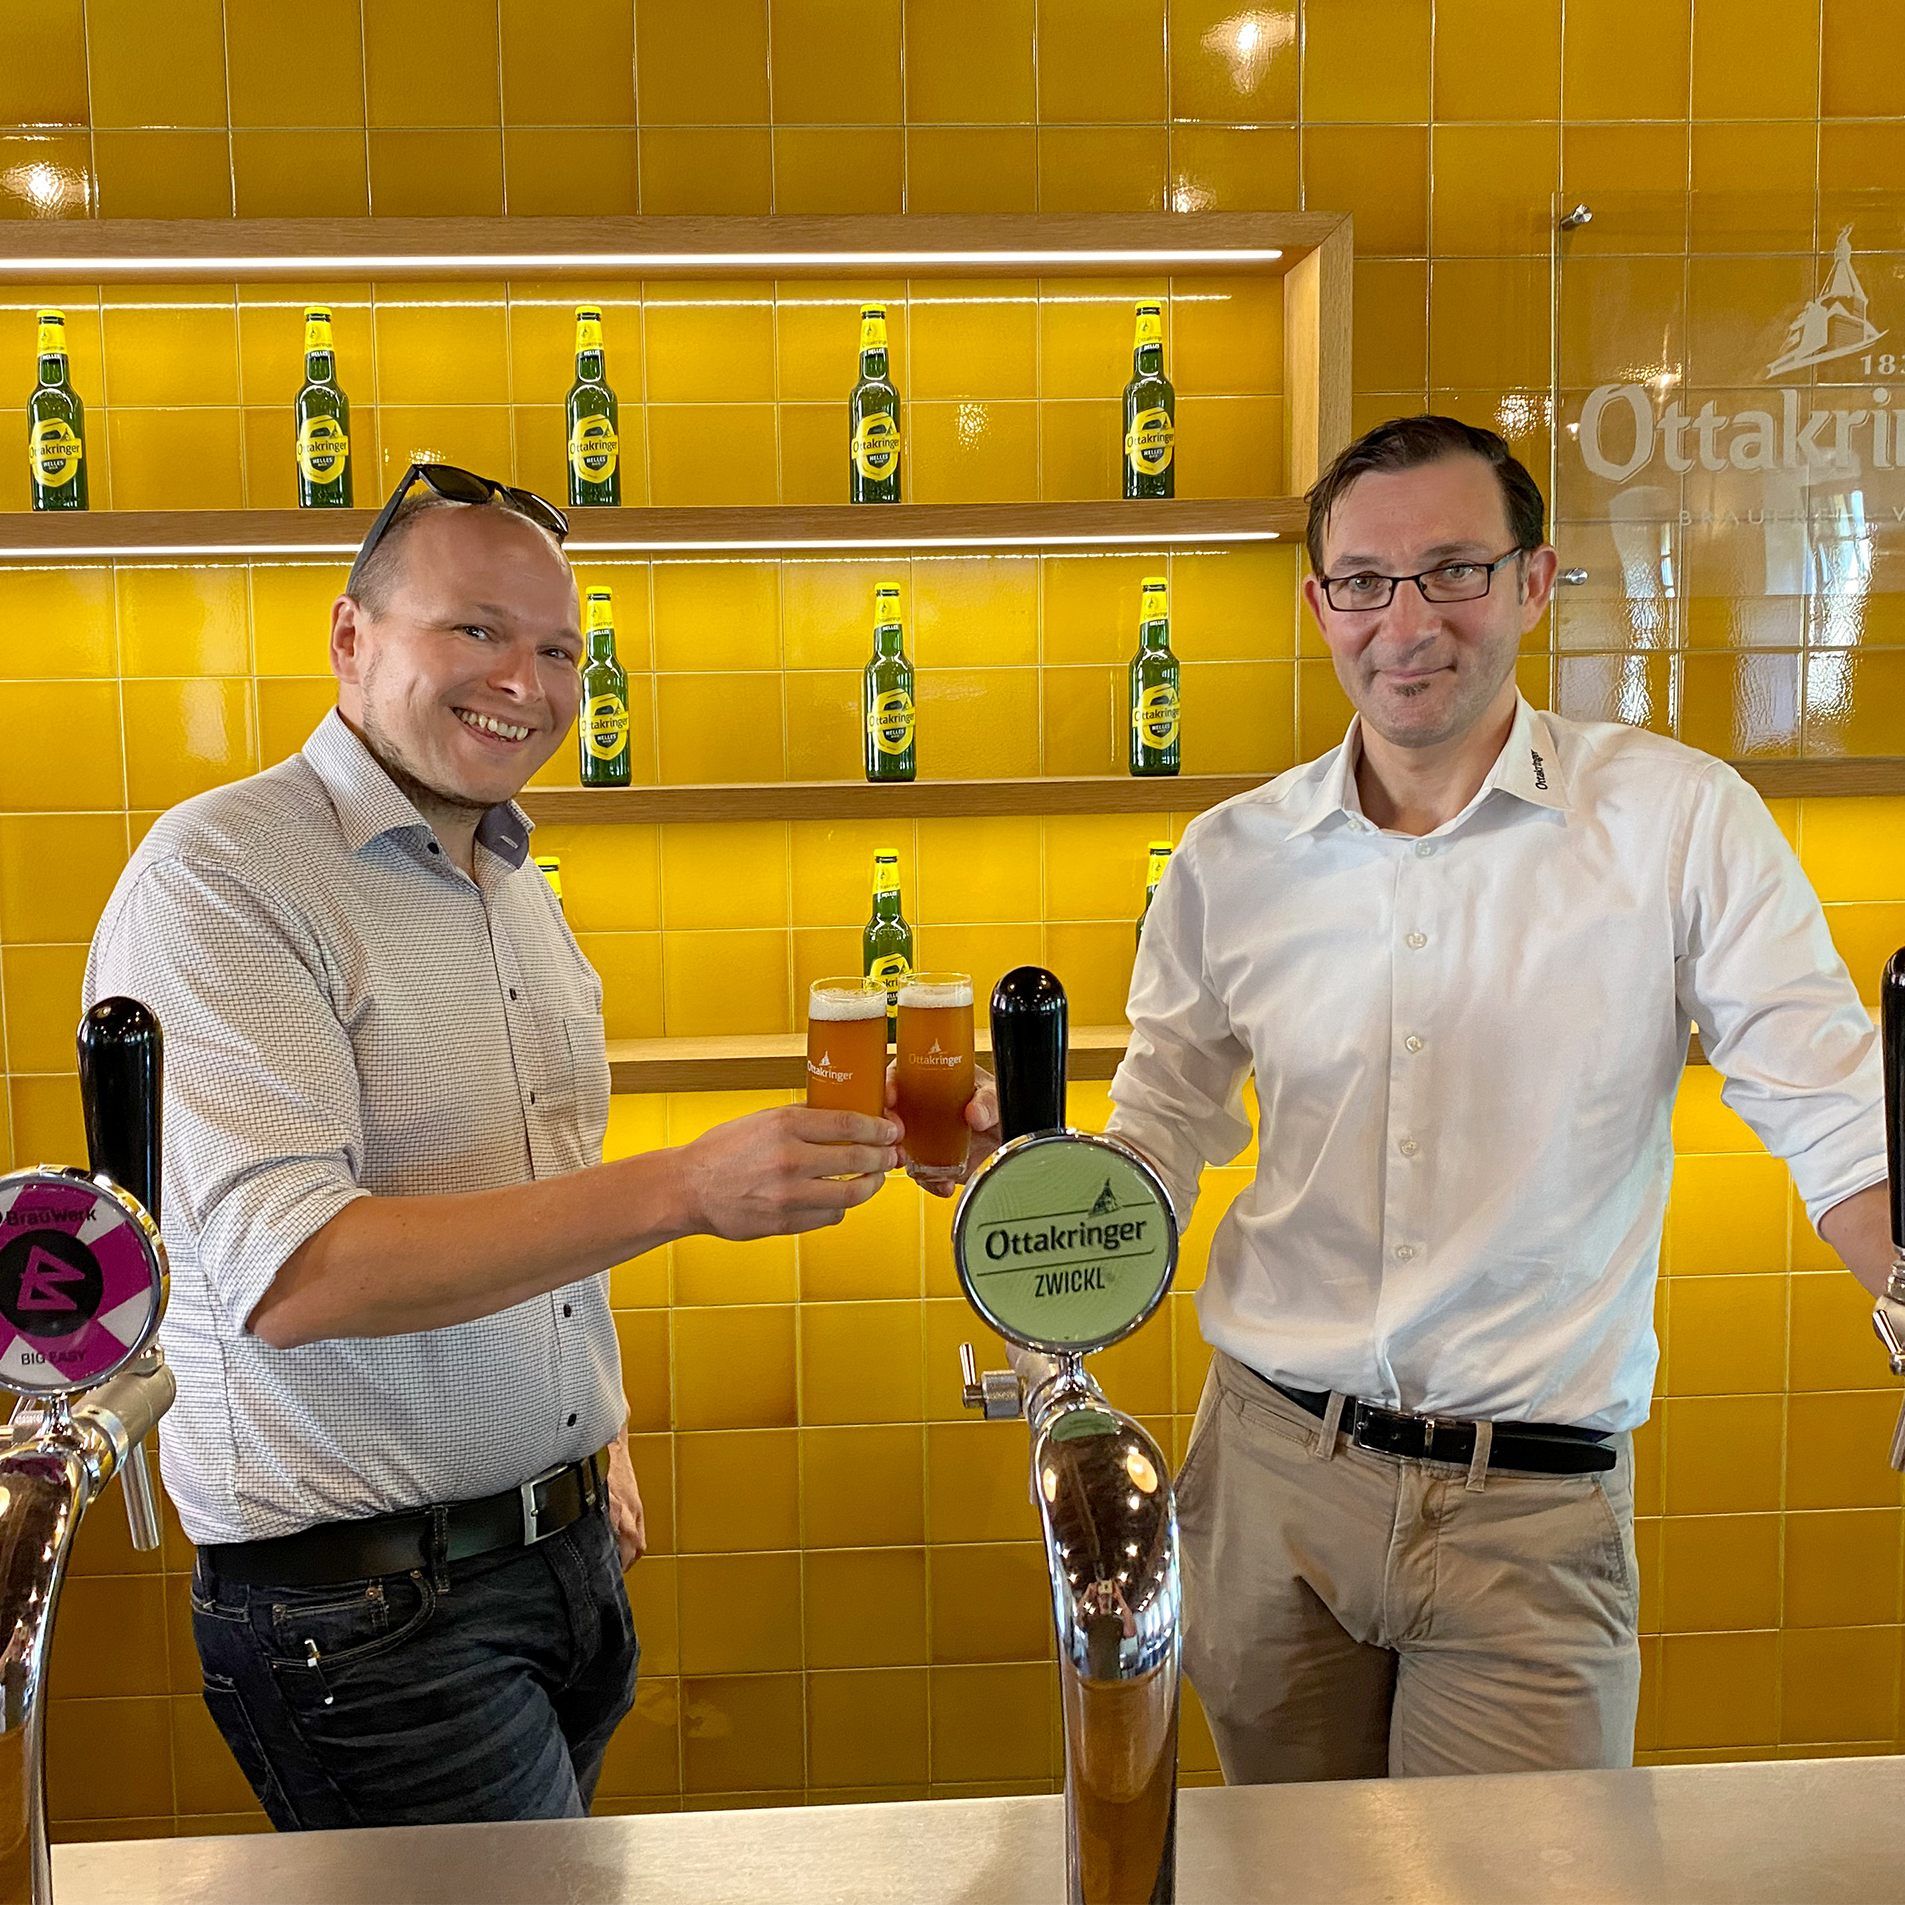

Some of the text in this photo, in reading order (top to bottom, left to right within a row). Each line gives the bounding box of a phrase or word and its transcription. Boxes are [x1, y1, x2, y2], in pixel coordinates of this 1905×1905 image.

[909, 1053, 963, 1067] Ottakringer
[985, 1219, 1147, 1260] Ottakringer
[1034, 1267, 1105, 1298] ZWICKL
[21, 1352, 45, 1365] BIG
